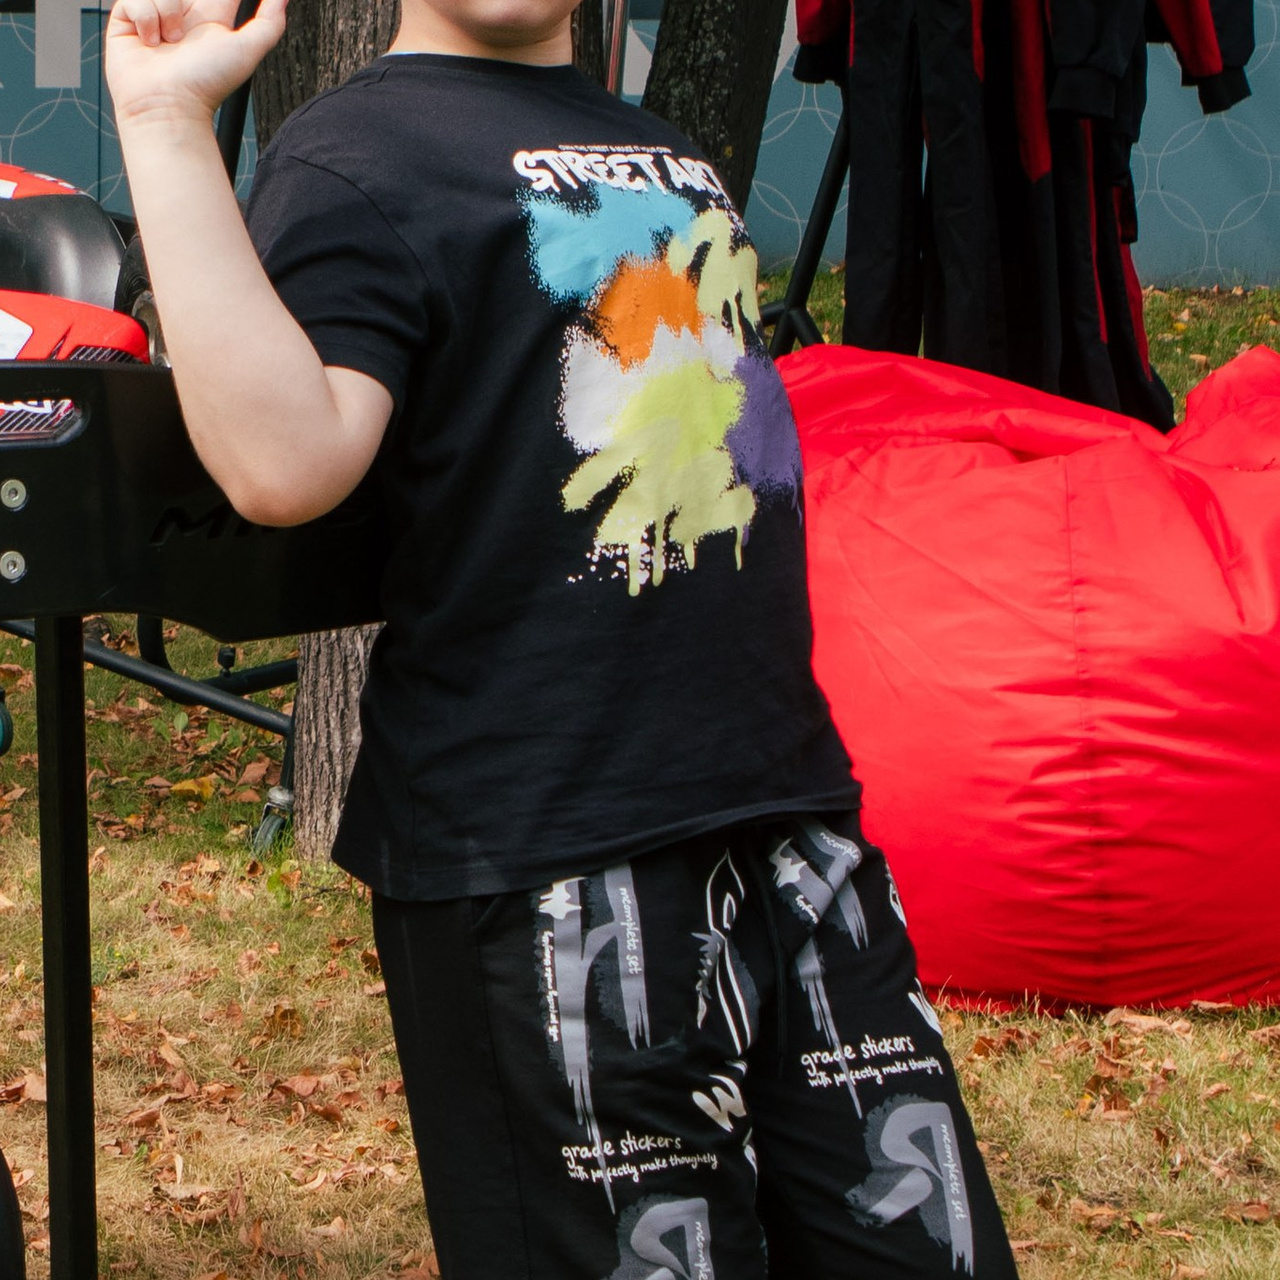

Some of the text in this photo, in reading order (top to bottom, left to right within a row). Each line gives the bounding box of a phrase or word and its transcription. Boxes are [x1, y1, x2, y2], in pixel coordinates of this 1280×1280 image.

[513, 150, 724, 196] STREET ART
[626, 954, 643, 974] set
[801, 1034, 915, 1077] grade stickers
[808, 1071, 832, 1087] with
[882, 1061, 908, 1076] make
[562, 1130, 682, 1168] grade stickers
[568, 1164, 589, 1181] with
[640, 1158, 668, 1174] make
[952, 1199, 968, 1221] set
